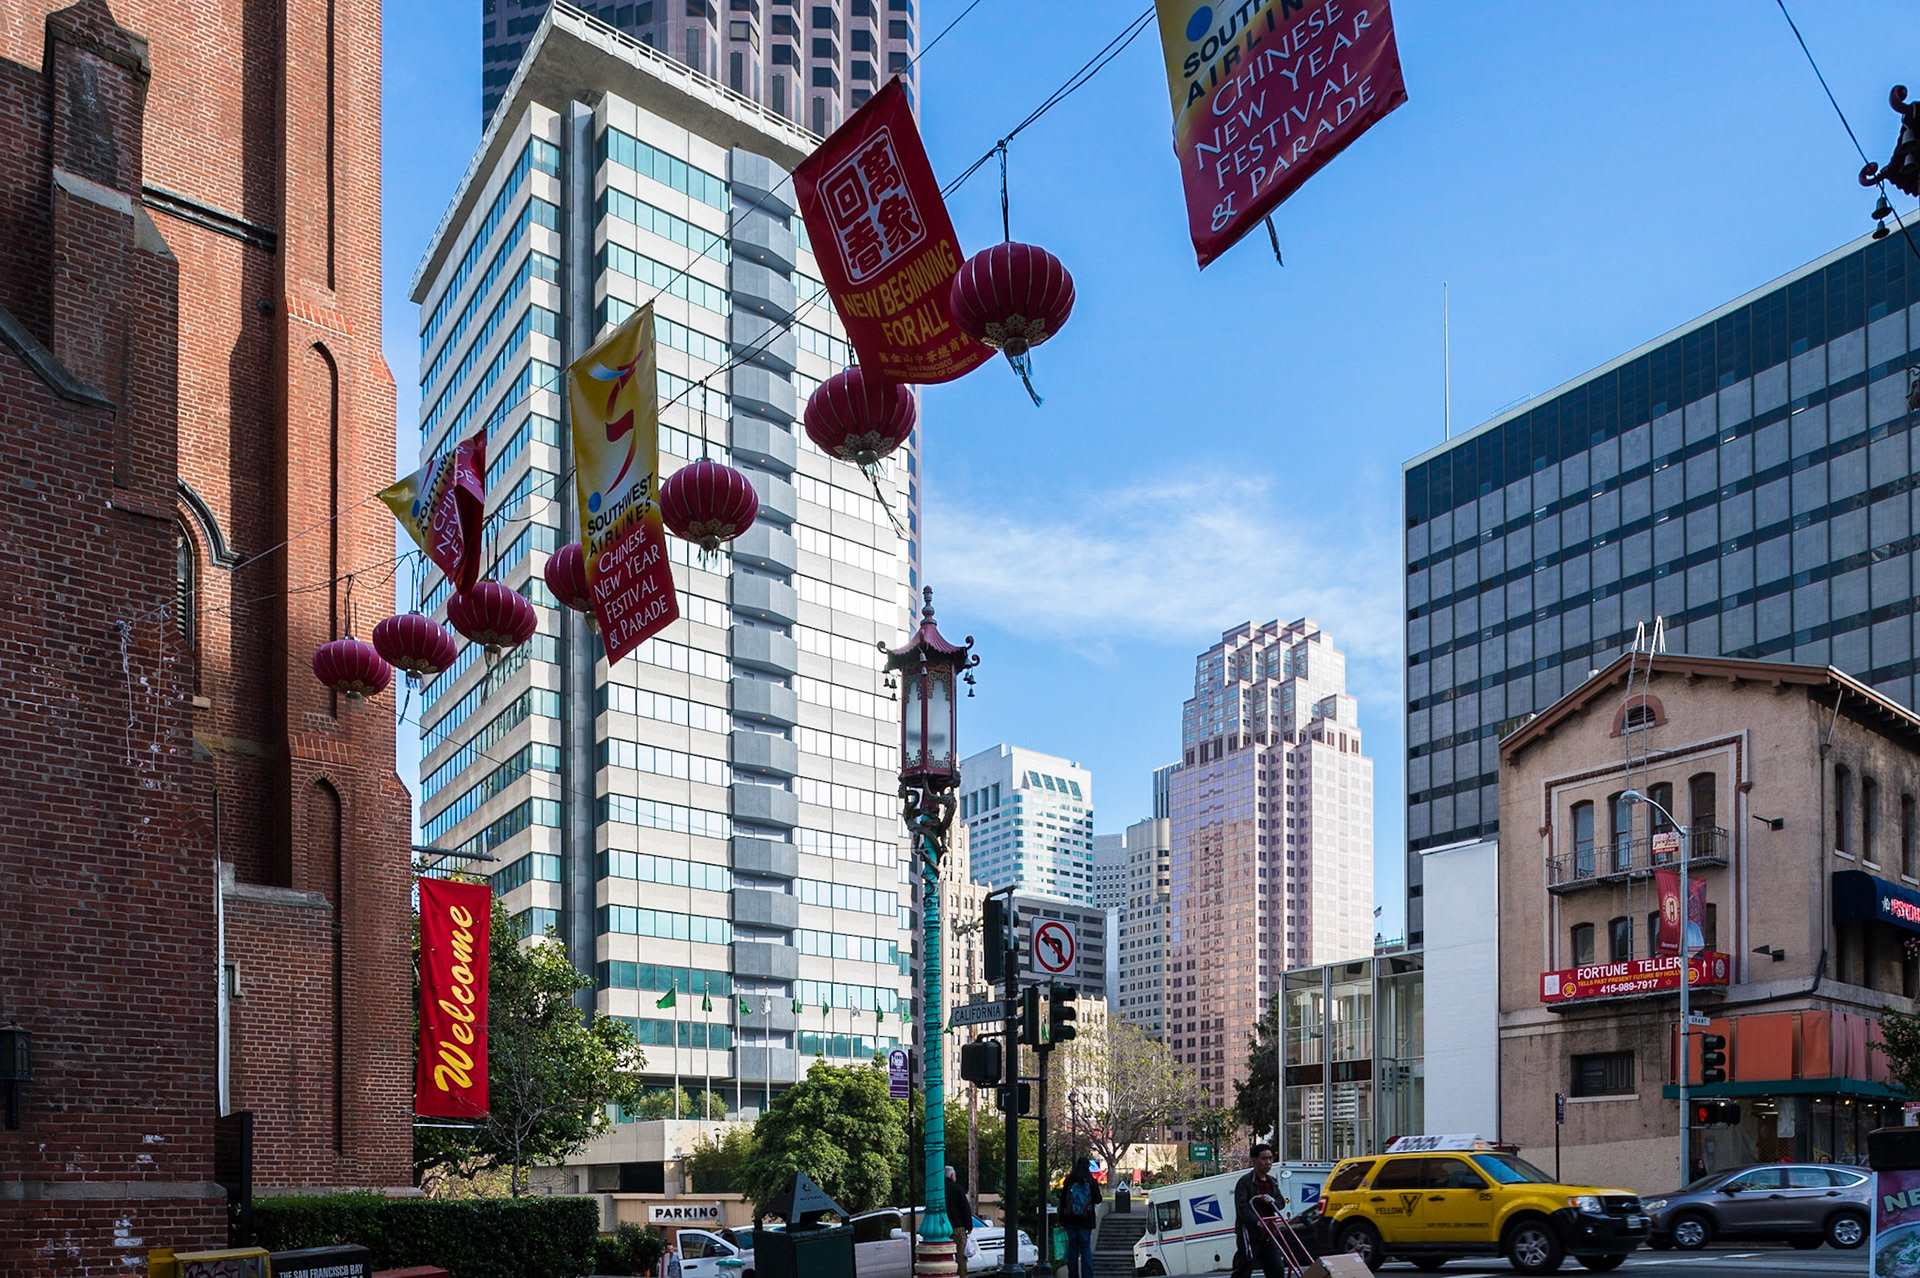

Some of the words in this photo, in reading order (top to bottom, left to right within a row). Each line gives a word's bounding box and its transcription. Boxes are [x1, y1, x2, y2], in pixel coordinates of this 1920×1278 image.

[1212, 0, 1343, 116] CHINESE
[1195, 90, 1266, 170] NEW
[1280, 10, 1371, 92] YEAR
[1211, 191, 1237, 232] &
[1250, 75, 1375, 199] PARADE
[1216, 63, 1358, 189] FESTIVAL
[825, 164, 884, 277] 回春
[840, 288, 880, 320] NEW
[879, 239, 957, 317] BEGINNING
[881, 315, 921, 347] FOR
[918, 298, 950, 342] ALL
[587, 472, 654, 537] SOUTHWEST
[589, 496, 652, 558] AIRLINES
[594, 573, 622, 604] NEW
[623, 544, 661, 577] YEAR
[599, 524, 646, 574] CHINESE
[604, 575, 658, 624] FESTIVAL
[610, 630, 620, 650] &
[620, 594, 669, 635] PARADE
[1577, 963, 1629, 981] FORTUNE
[1637, 957, 1682, 974] TELLER
[1577, 979, 1593, 987] TELLS
[1593, 977, 1607, 986] PAST
[1608, 975, 1632, 984] PRESENT
[1633, 972, 1655, 981] FUTURE
[1655, 971, 1663, 979] BY
[1664, 969, 1682, 978] HOLLY
[1600, 979, 1659, 994] 415-989-7917
[434, 905, 476, 1092] Welcome
[954, 1005, 1001, 1022] CALIFORNIA
[655, 1207, 718, 1218] PARKING
[1374, 1207, 1404, 1215] YELLOW
[293, 1269, 309, 1278] SAN
[310, 1265, 349, 1278] FRANCISCO
[349, 1263, 364, 1275] BAY
